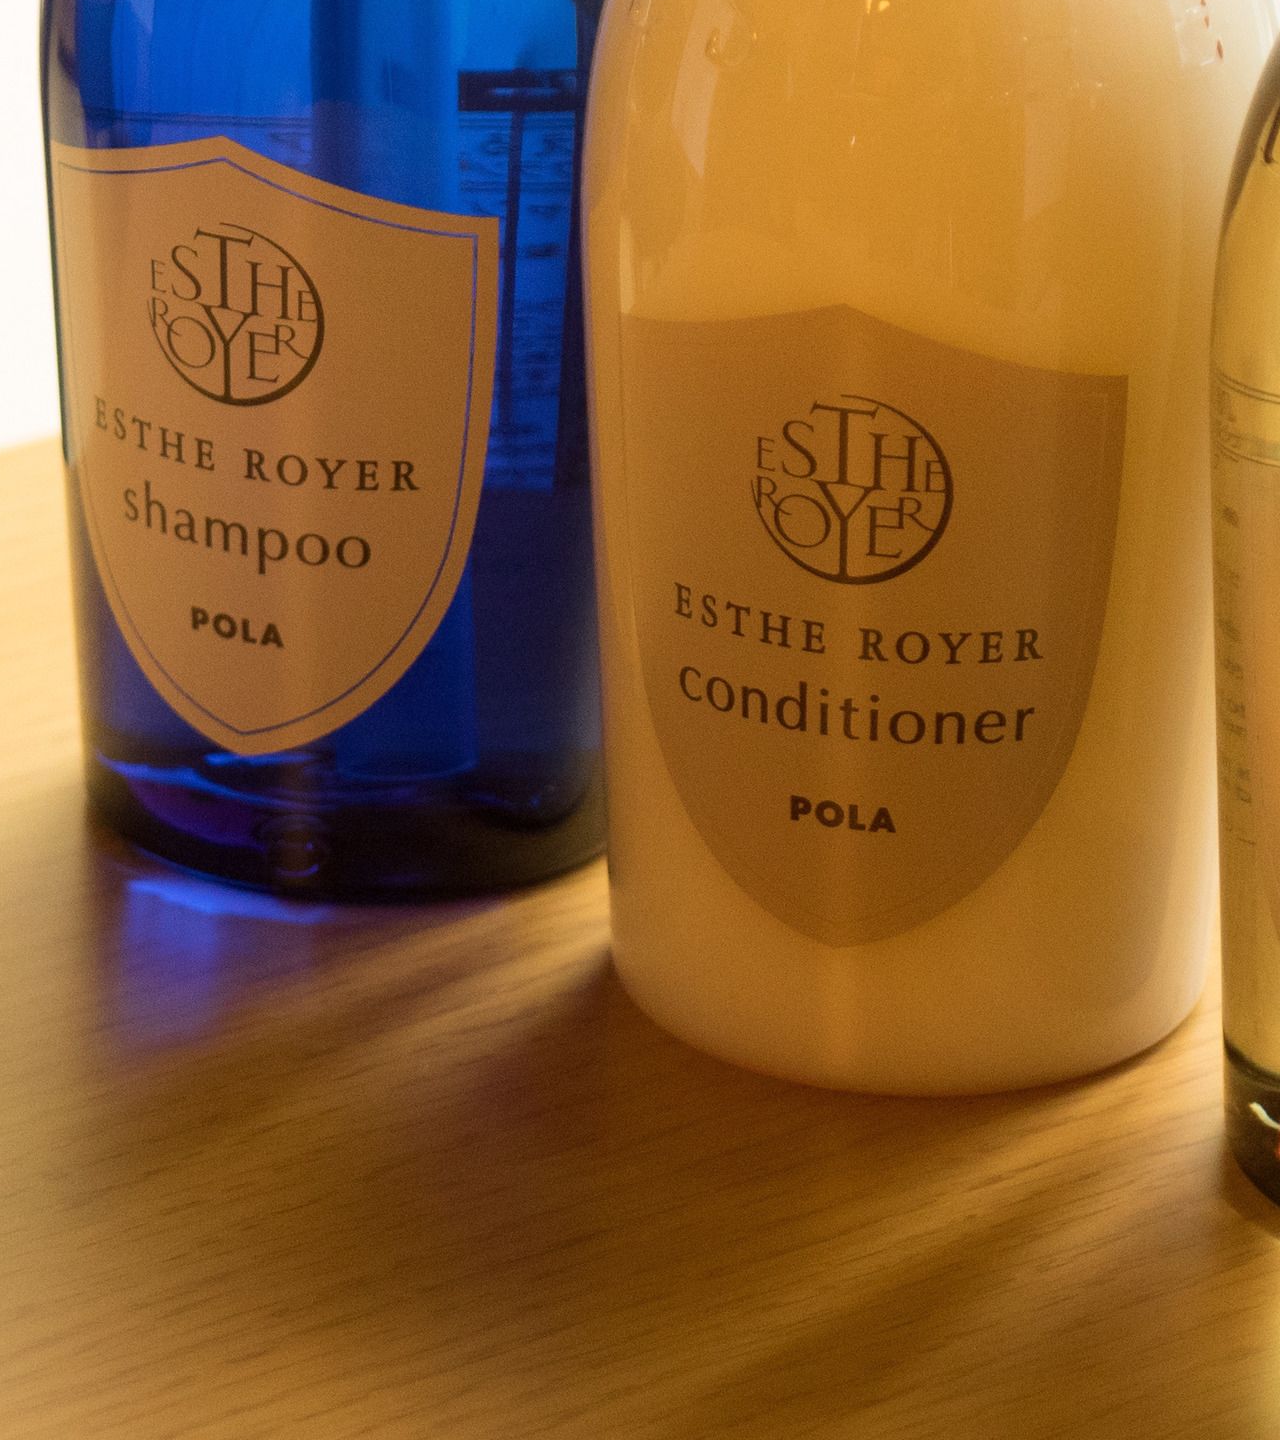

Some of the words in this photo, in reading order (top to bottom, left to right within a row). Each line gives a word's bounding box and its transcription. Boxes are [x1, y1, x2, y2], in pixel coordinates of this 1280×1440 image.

[94, 395, 216, 472] ESTHE
[242, 446, 421, 494] ROYER
[123, 480, 372, 575] shampoo
[190, 605, 285, 649] POLA
[673, 581, 826, 655] ESTHE
[857, 627, 1044, 665] ROYER
[678, 665, 1036, 745] conditioner
[789, 794, 897, 834] POLA
